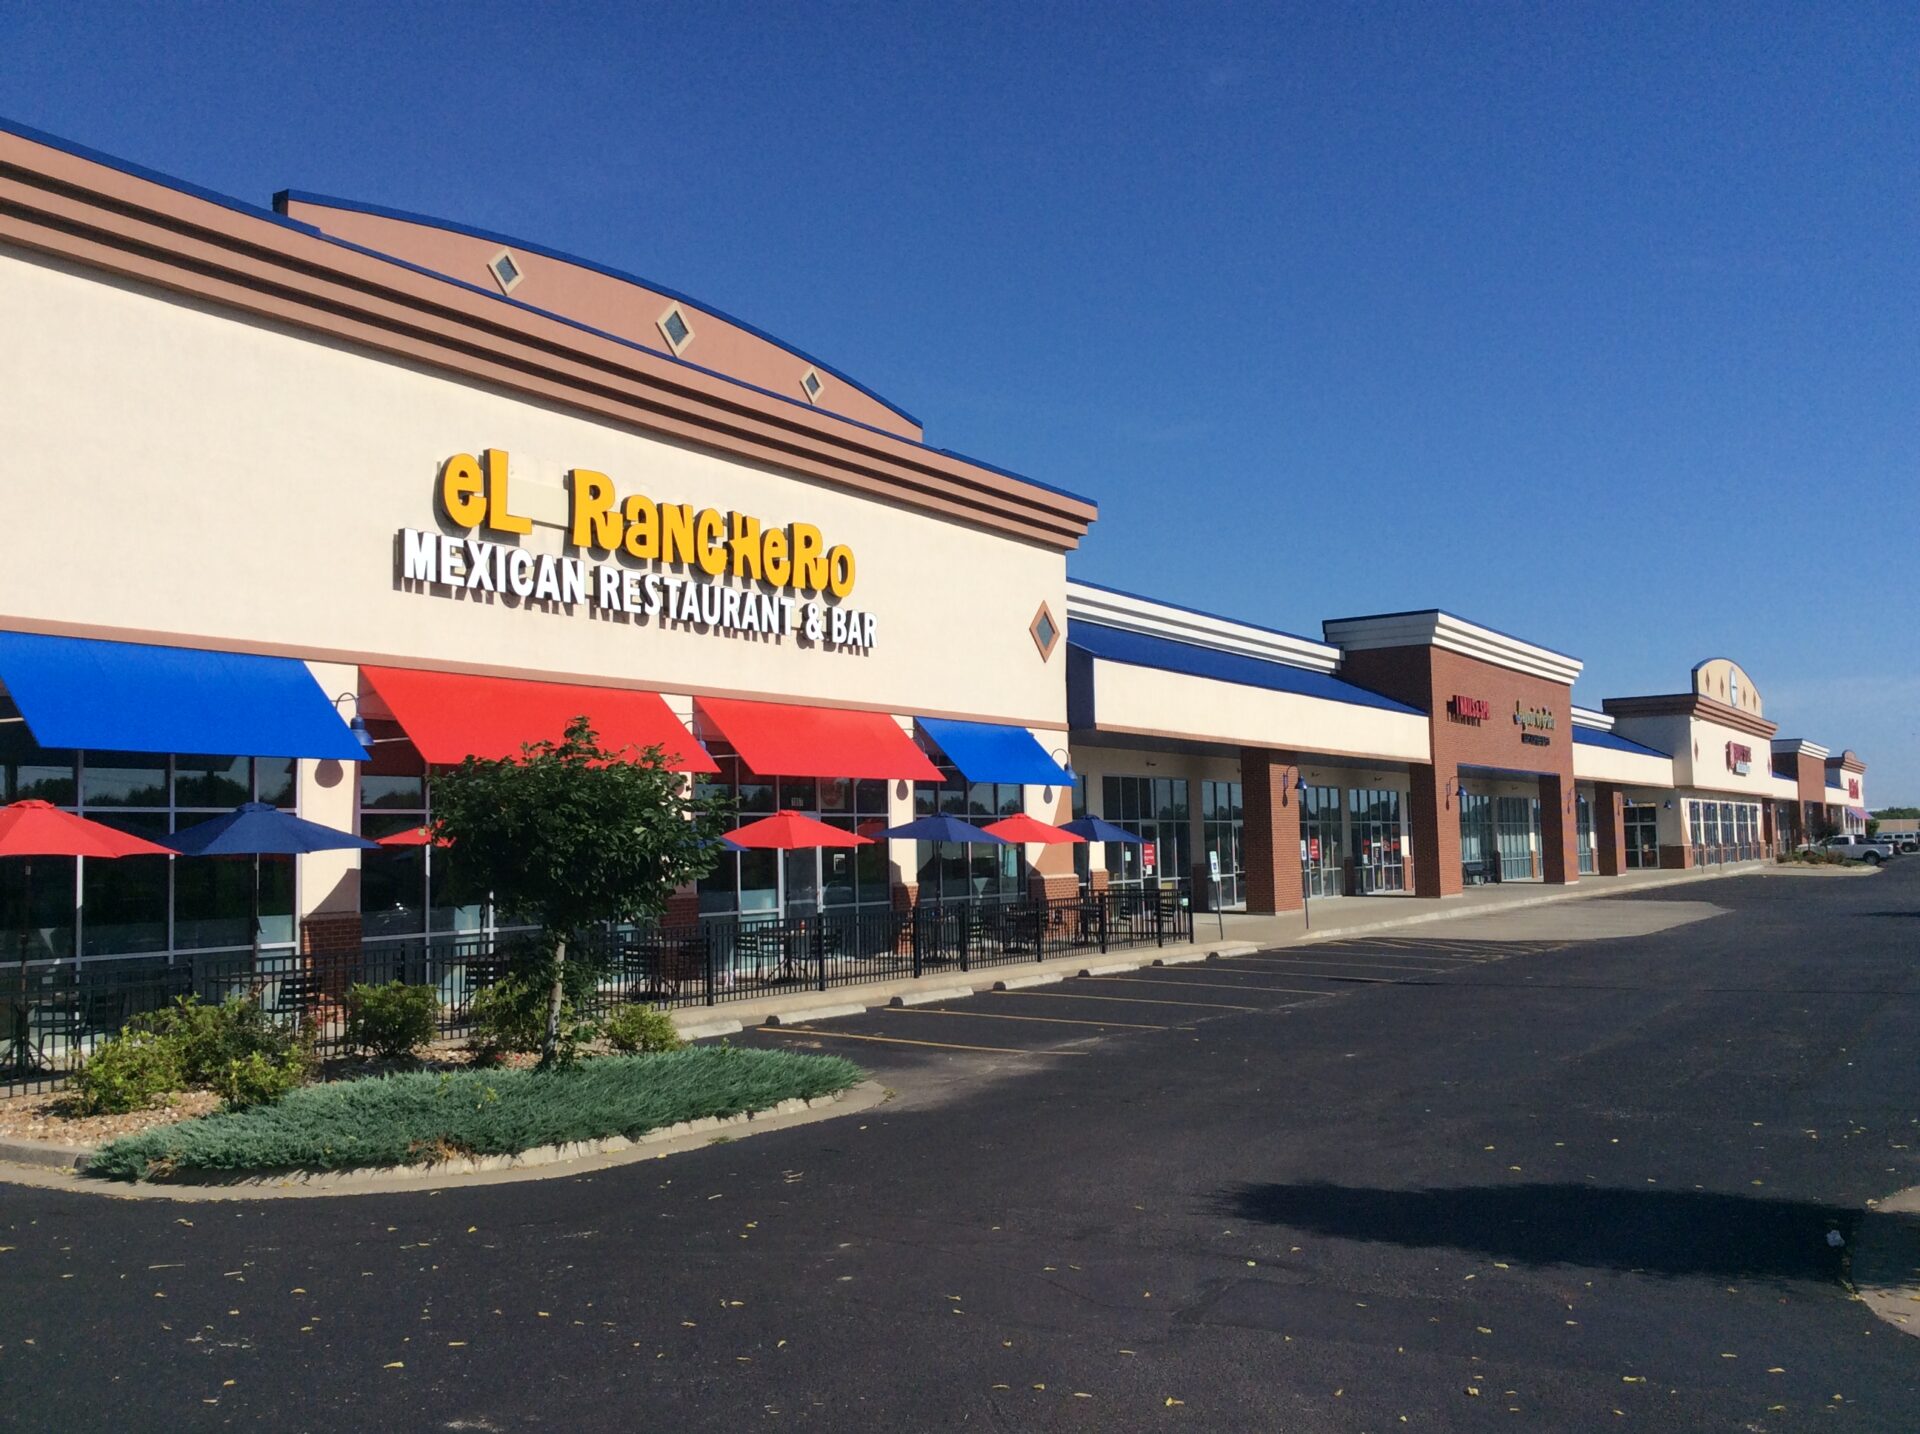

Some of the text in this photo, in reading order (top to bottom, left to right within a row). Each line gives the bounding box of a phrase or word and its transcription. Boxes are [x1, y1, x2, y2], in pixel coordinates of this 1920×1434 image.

[403, 527, 878, 648] MEXICAN RESTAURANT & BAR
